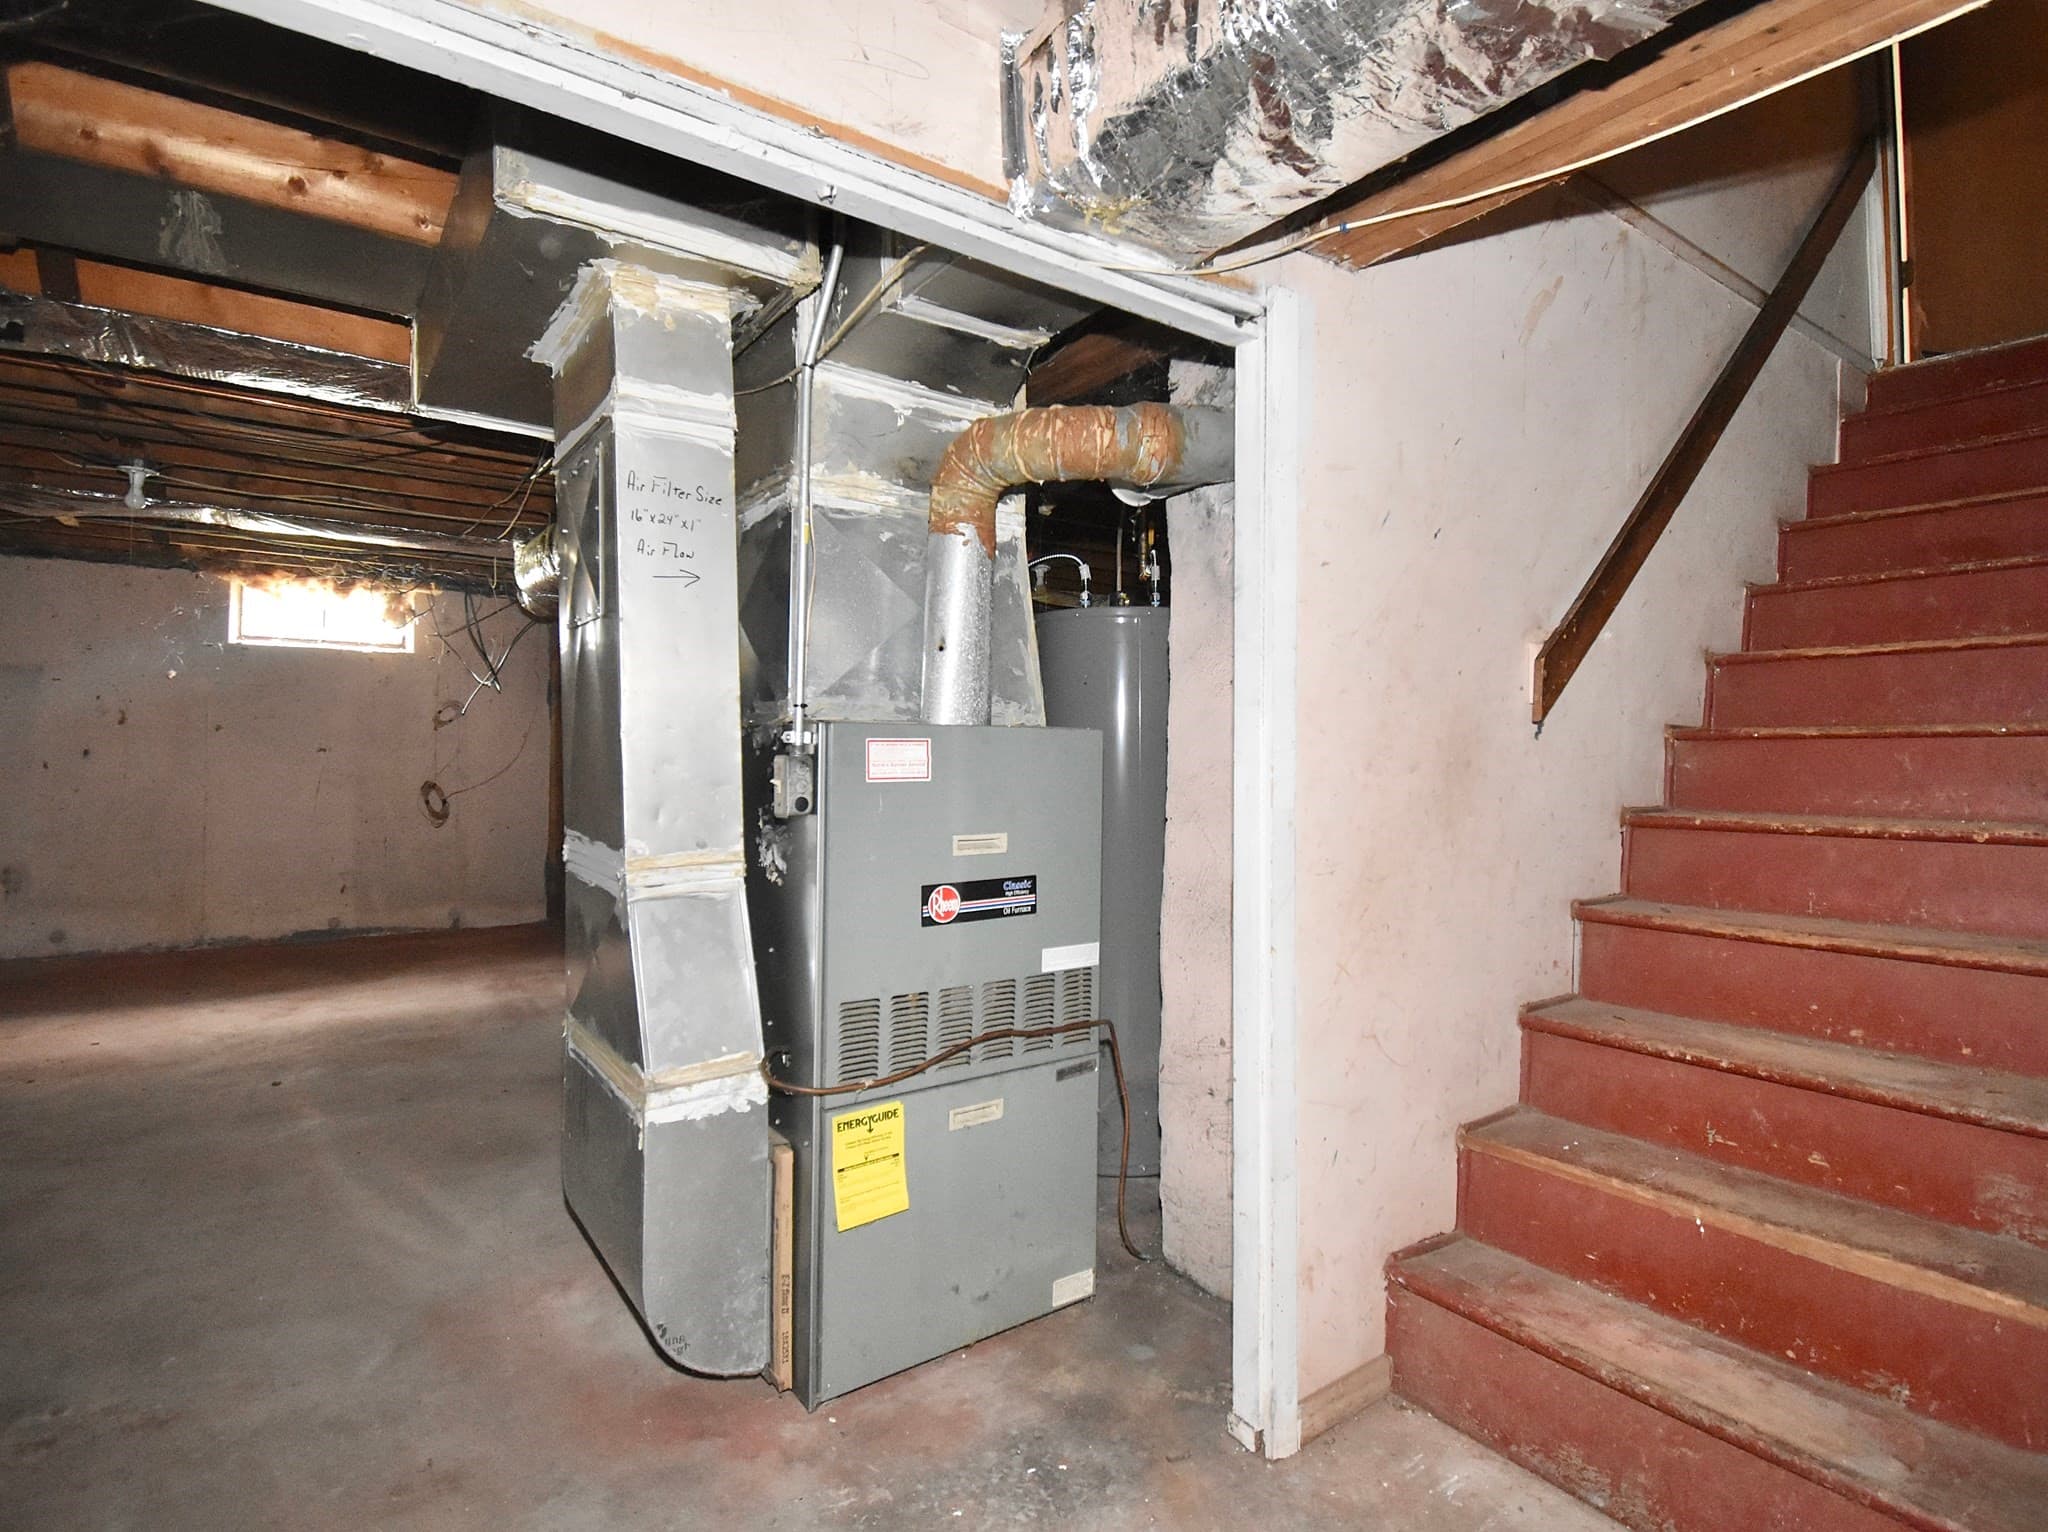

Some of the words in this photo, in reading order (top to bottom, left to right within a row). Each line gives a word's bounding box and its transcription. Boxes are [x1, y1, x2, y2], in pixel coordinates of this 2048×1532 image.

[627, 470, 645, 491] Air
[651, 475, 692, 500] Filter
[696, 485, 723, 506] Size
[637, 538, 655, 555] Air
[663, 541, 695, 559] Flow
[1003, 880, 1032, 890] Classic
[931, 887, 959, 918] Rheem
[1003, 906, 1011, 915] Oil
[1012, 905, 1031, 914] Furnace
[837, 1108, 899, 1133] ENERGYGUIDE
